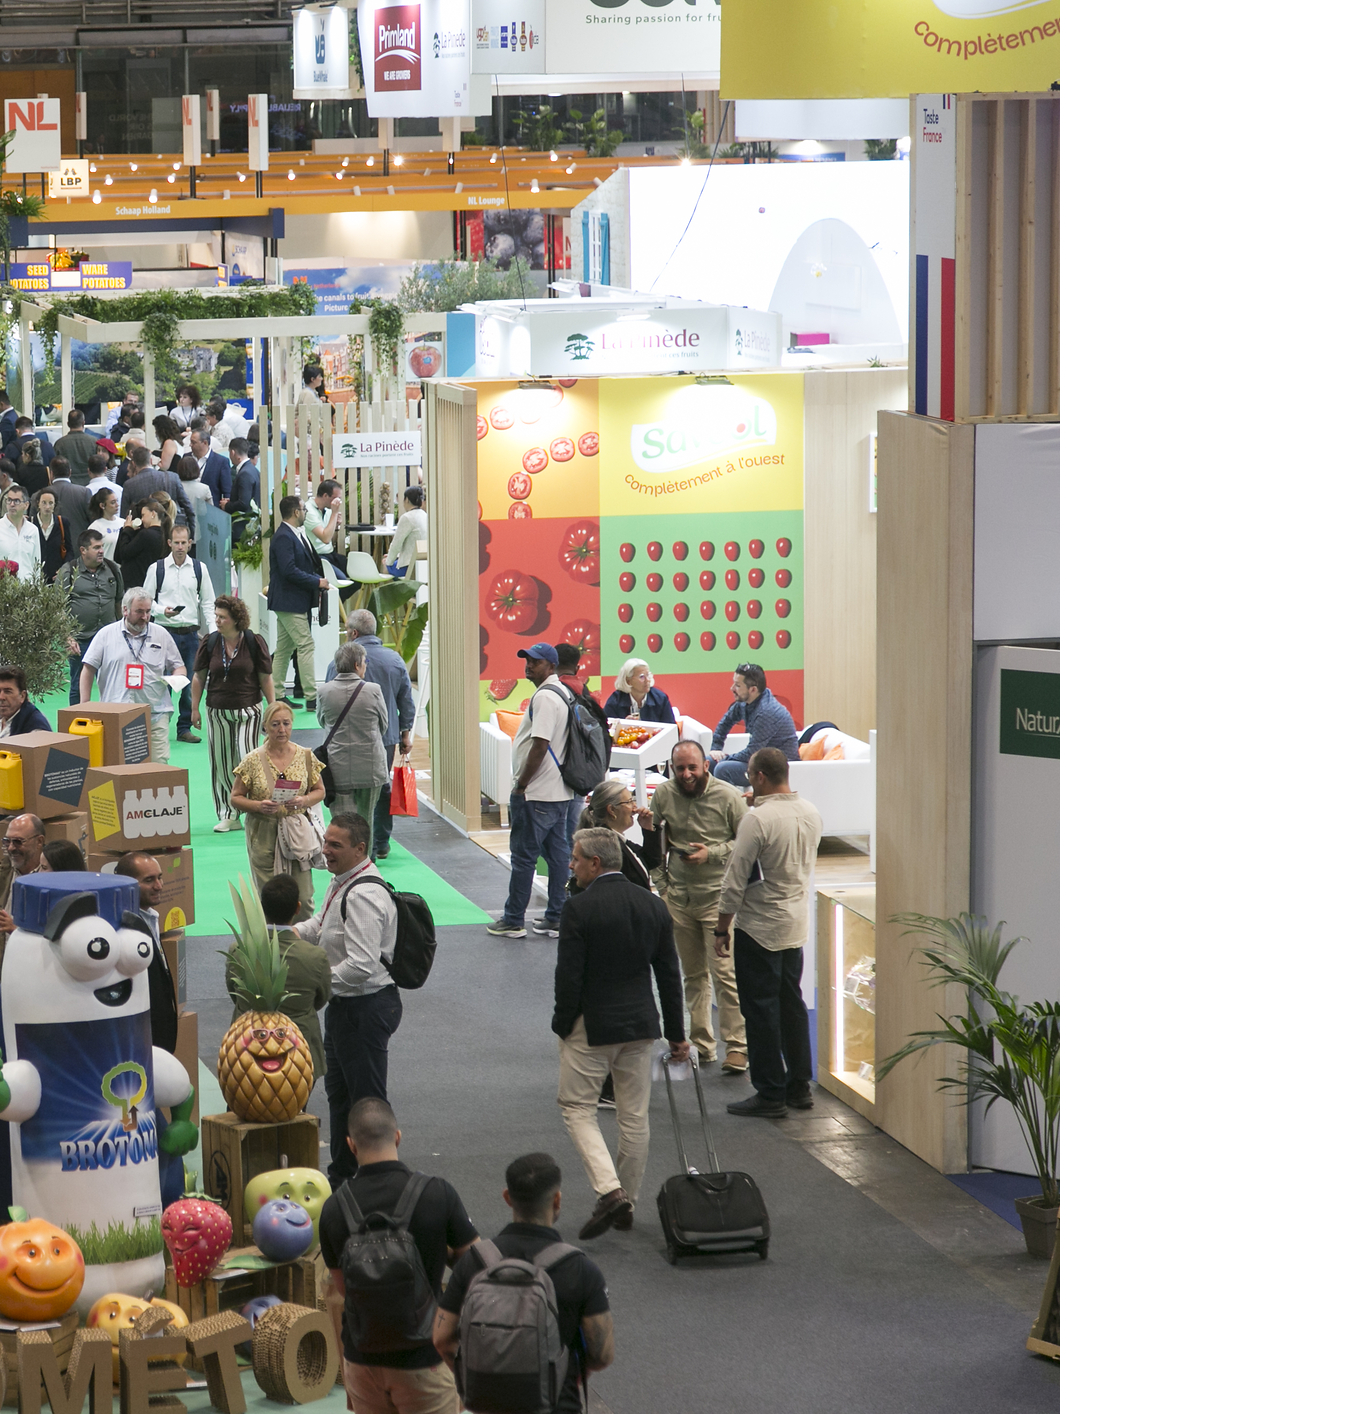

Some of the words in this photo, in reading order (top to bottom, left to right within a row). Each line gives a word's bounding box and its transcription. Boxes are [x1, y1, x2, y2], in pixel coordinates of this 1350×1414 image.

[586, 14, 631, 25] Sharing
[635, 13, 681, 25] passion
[686, 13, 703, 23] for
[379, 22, 416, 52] Primland
[384, 71, 390, 81] WE
[8, 101, 58, 131] NL
[923, 108, 939, 125] Taste
[922, 127, 942, 144] France
[60, 177, 82, 186] LBP
[468, 197, 477, 205] NL
[478, 196, 505, 206] Lounge
[115, 205, 140, 216] Schaap
[142, 204, 171, 215] Holland
[27, 265, 49, 276] SEED
[82, 264, 108, 275] WARE
[82, 277, 126, 289] POTATOES
[324, 294, 345, 302] canals
[324, 304, 348, 312] Picture
[681, 350, 699, 359] fruits
[642, 405, 767, 459] Saol
[360, 443, 372, 452] La
[375, 441, 414, 451] Pinède
[625, 466, 723, 497] complètement
[726, 461, 736, 473] à
[738, 454, 785, 470] l'ouest
[1017, 707, 1060, 734] Natur
[126, 806, 183, 820] AMCLAJE
